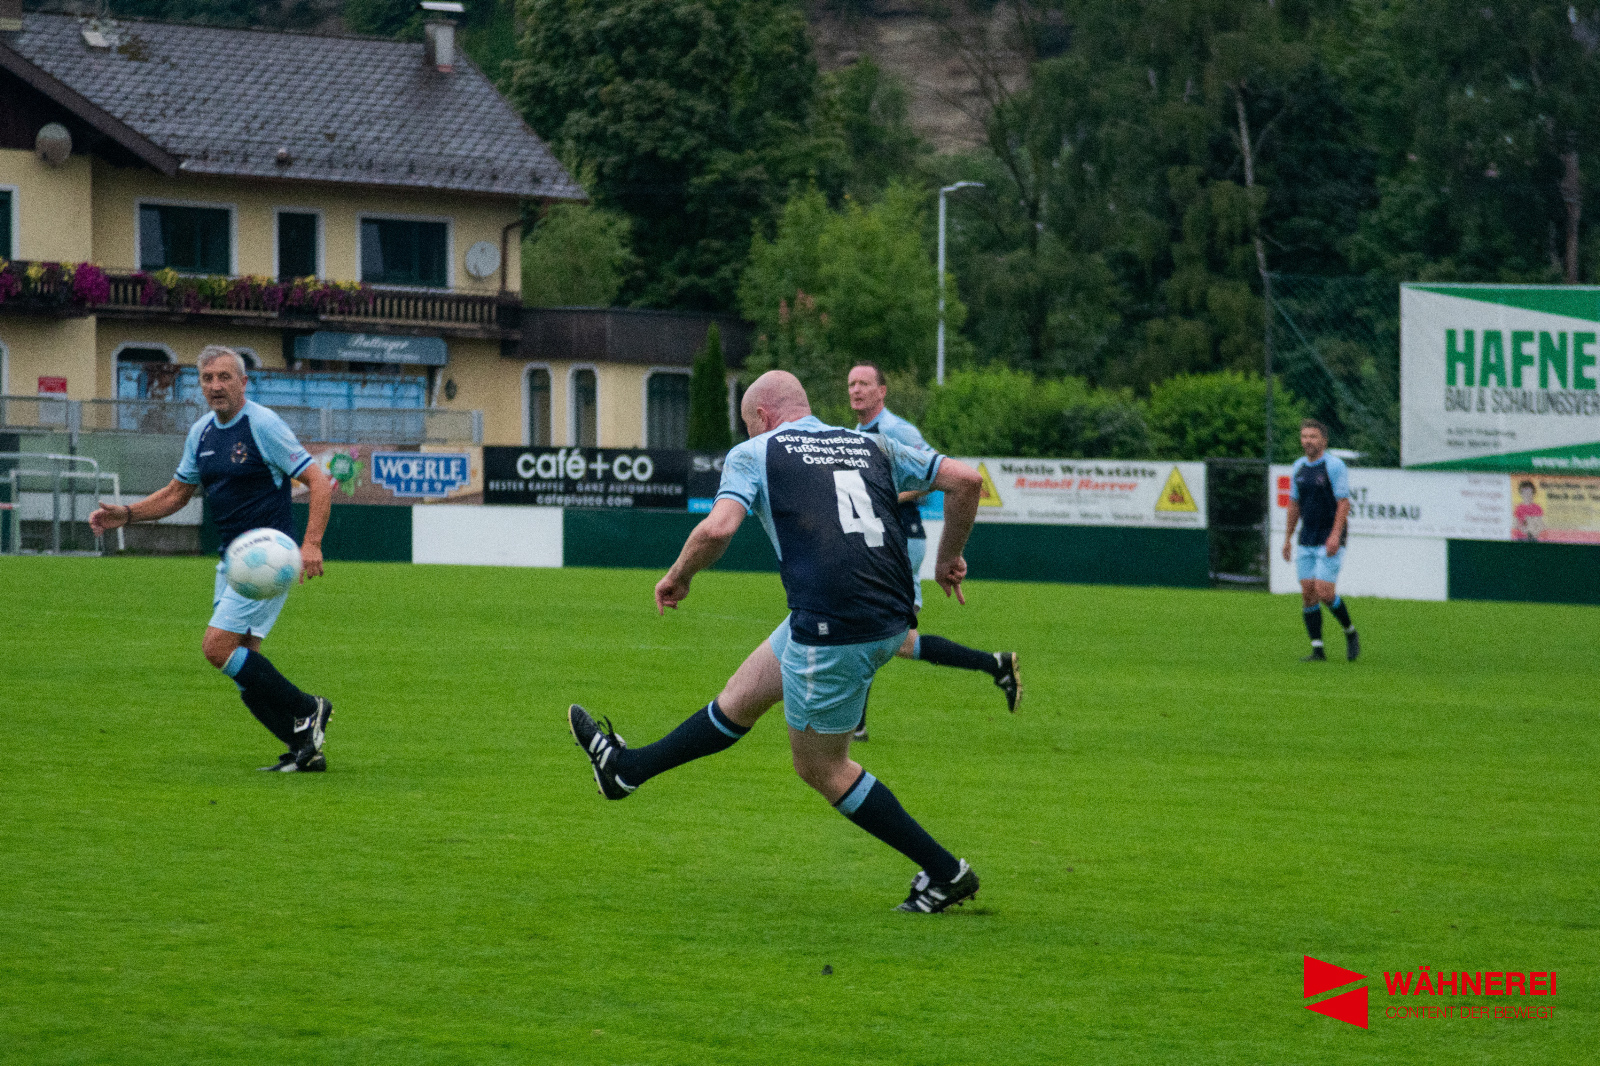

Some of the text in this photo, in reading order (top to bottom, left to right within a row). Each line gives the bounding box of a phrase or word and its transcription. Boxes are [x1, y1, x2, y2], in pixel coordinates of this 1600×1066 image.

[1446, 329, 1596, 390] HAFNE
[775, 434, 866, 446] Bürgermeister
[785, 444, 871, 457] Fußball-Team
[379, 458, 464, 481] WOERLE
[802, 454, 869, 469] Österreich
[833, 469, 885, 547] 4
